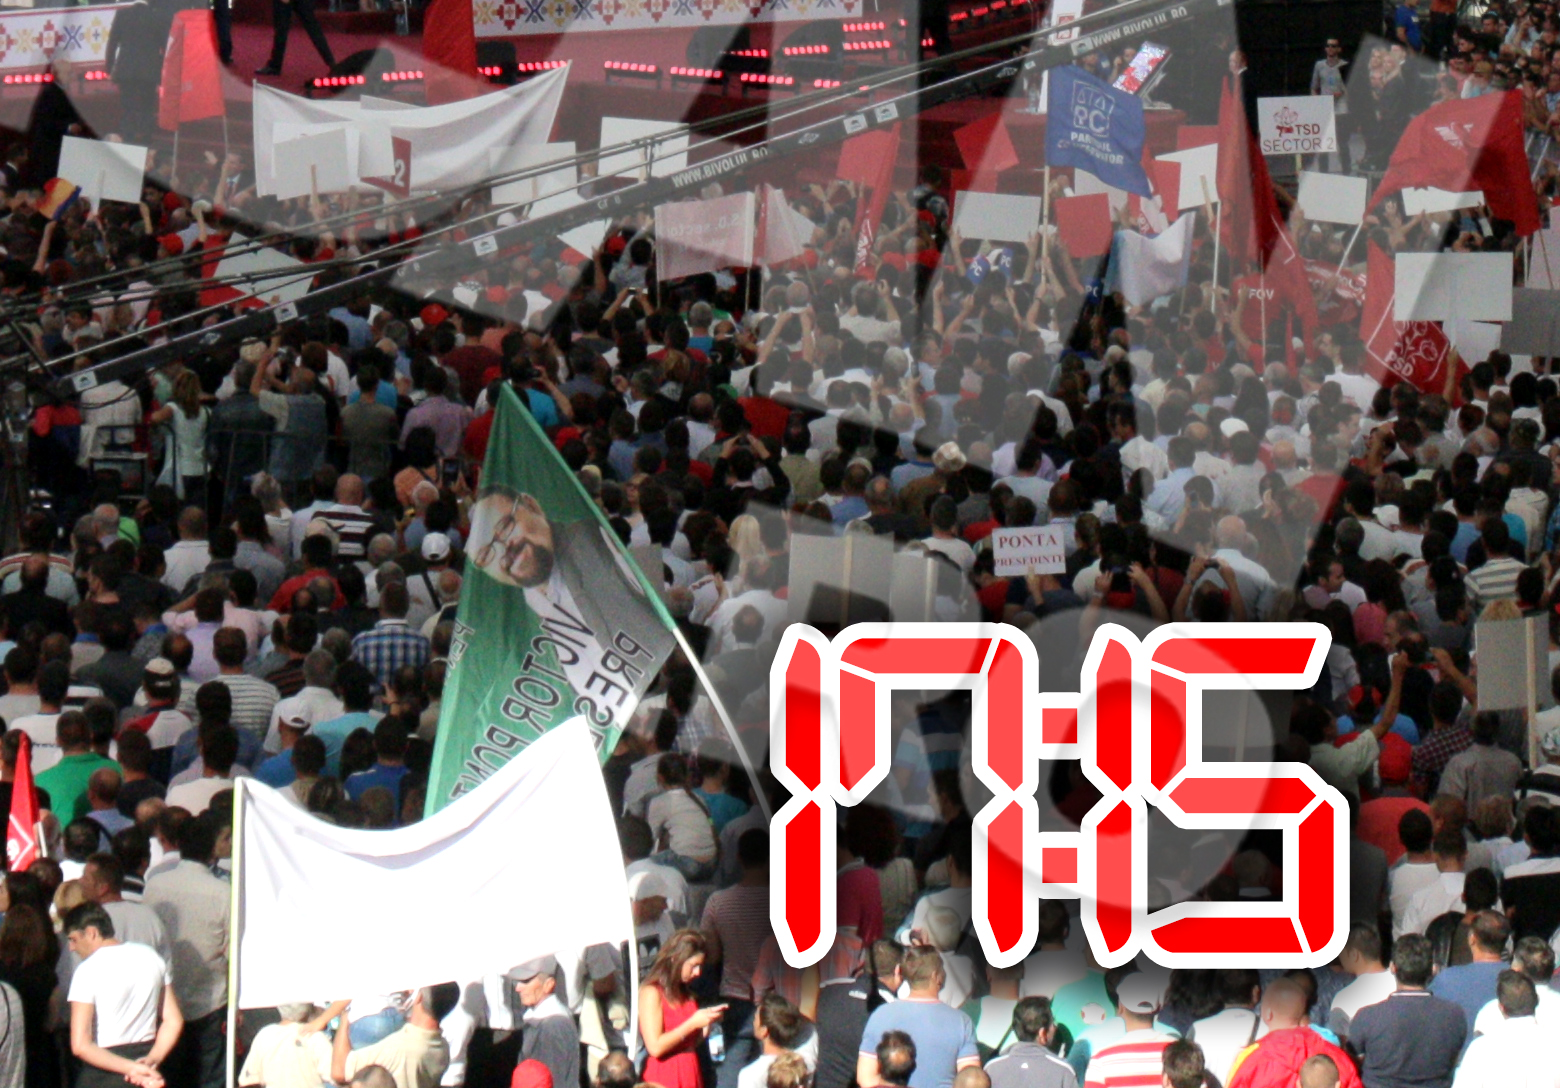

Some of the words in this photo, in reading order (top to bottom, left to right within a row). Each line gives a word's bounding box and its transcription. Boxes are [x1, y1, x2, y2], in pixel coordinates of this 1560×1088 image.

[1297, 124, 1320, 135] TSD
[1262, 136, 1322, 153] SECTOR
[1327, 136, 1334, 150] 2
[1386, 350, 1414, 377] PSD
[998, 533, 1058, 550] PONTA
